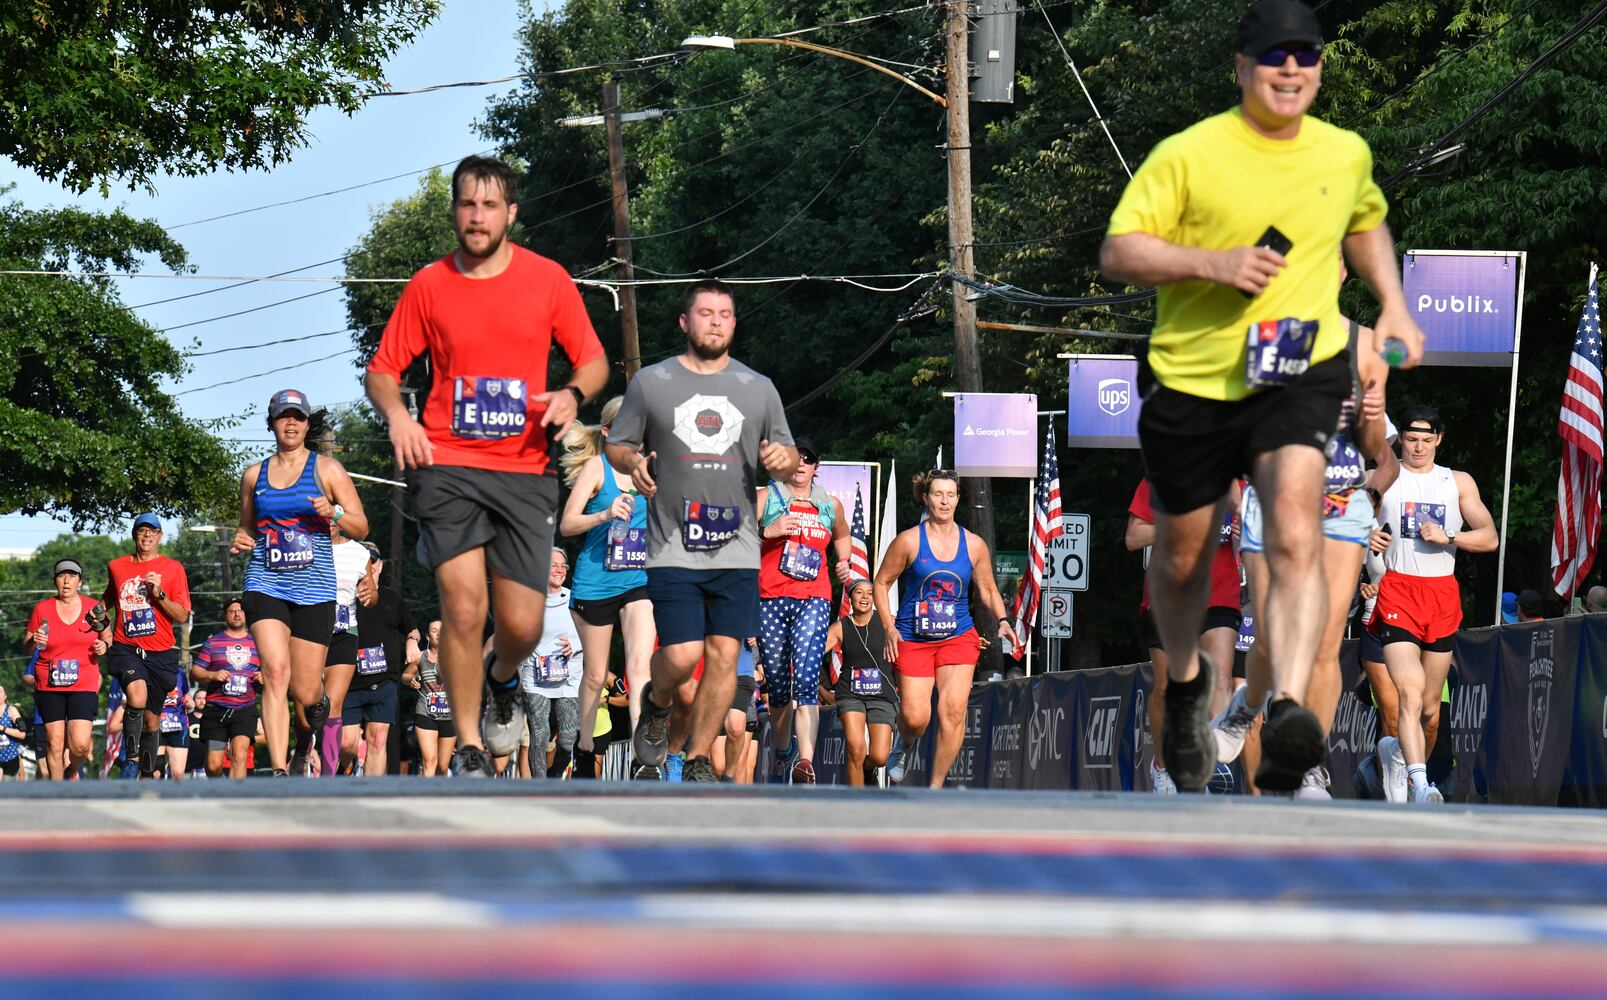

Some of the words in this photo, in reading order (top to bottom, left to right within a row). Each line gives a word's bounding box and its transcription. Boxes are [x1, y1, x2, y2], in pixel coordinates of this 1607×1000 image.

[1262, 346, 1278, 372] E
[1101, 389, 1128, 410] ups
[465, 403, 477, 423] E
[481, 411, 525, 426] 15010
[698, 416, 720, 428] ATL
[976, 428, 1004, 437] Georgia
[1006, 428, 1029, 436] Power
[1325, 465, 1360, 479] 4963
[1408, 517, 1415, 529] E
[689, 524, 703, 540] D
[271, 549, 281, 562] D
[284, 550, 313, 561] 12215
[615, 546, 623, 560] E
[626, 552, 646, 561] 1550
[787, 557, 796, 569] E
[128, 622, 136, 632] A
[137, 621, 155, 631] 2865
[922, 618, 929, 629] E
[932, 621, 957, 630] 14344
[1239, 635, 1255, 644] 149
[361, 660, 367, 669] E
[541, 667, 548, 676] E
[855, 680, 861, 689] E
[430, 705, 437, 713] D
[823, 737, 846, 765] ULTRA
